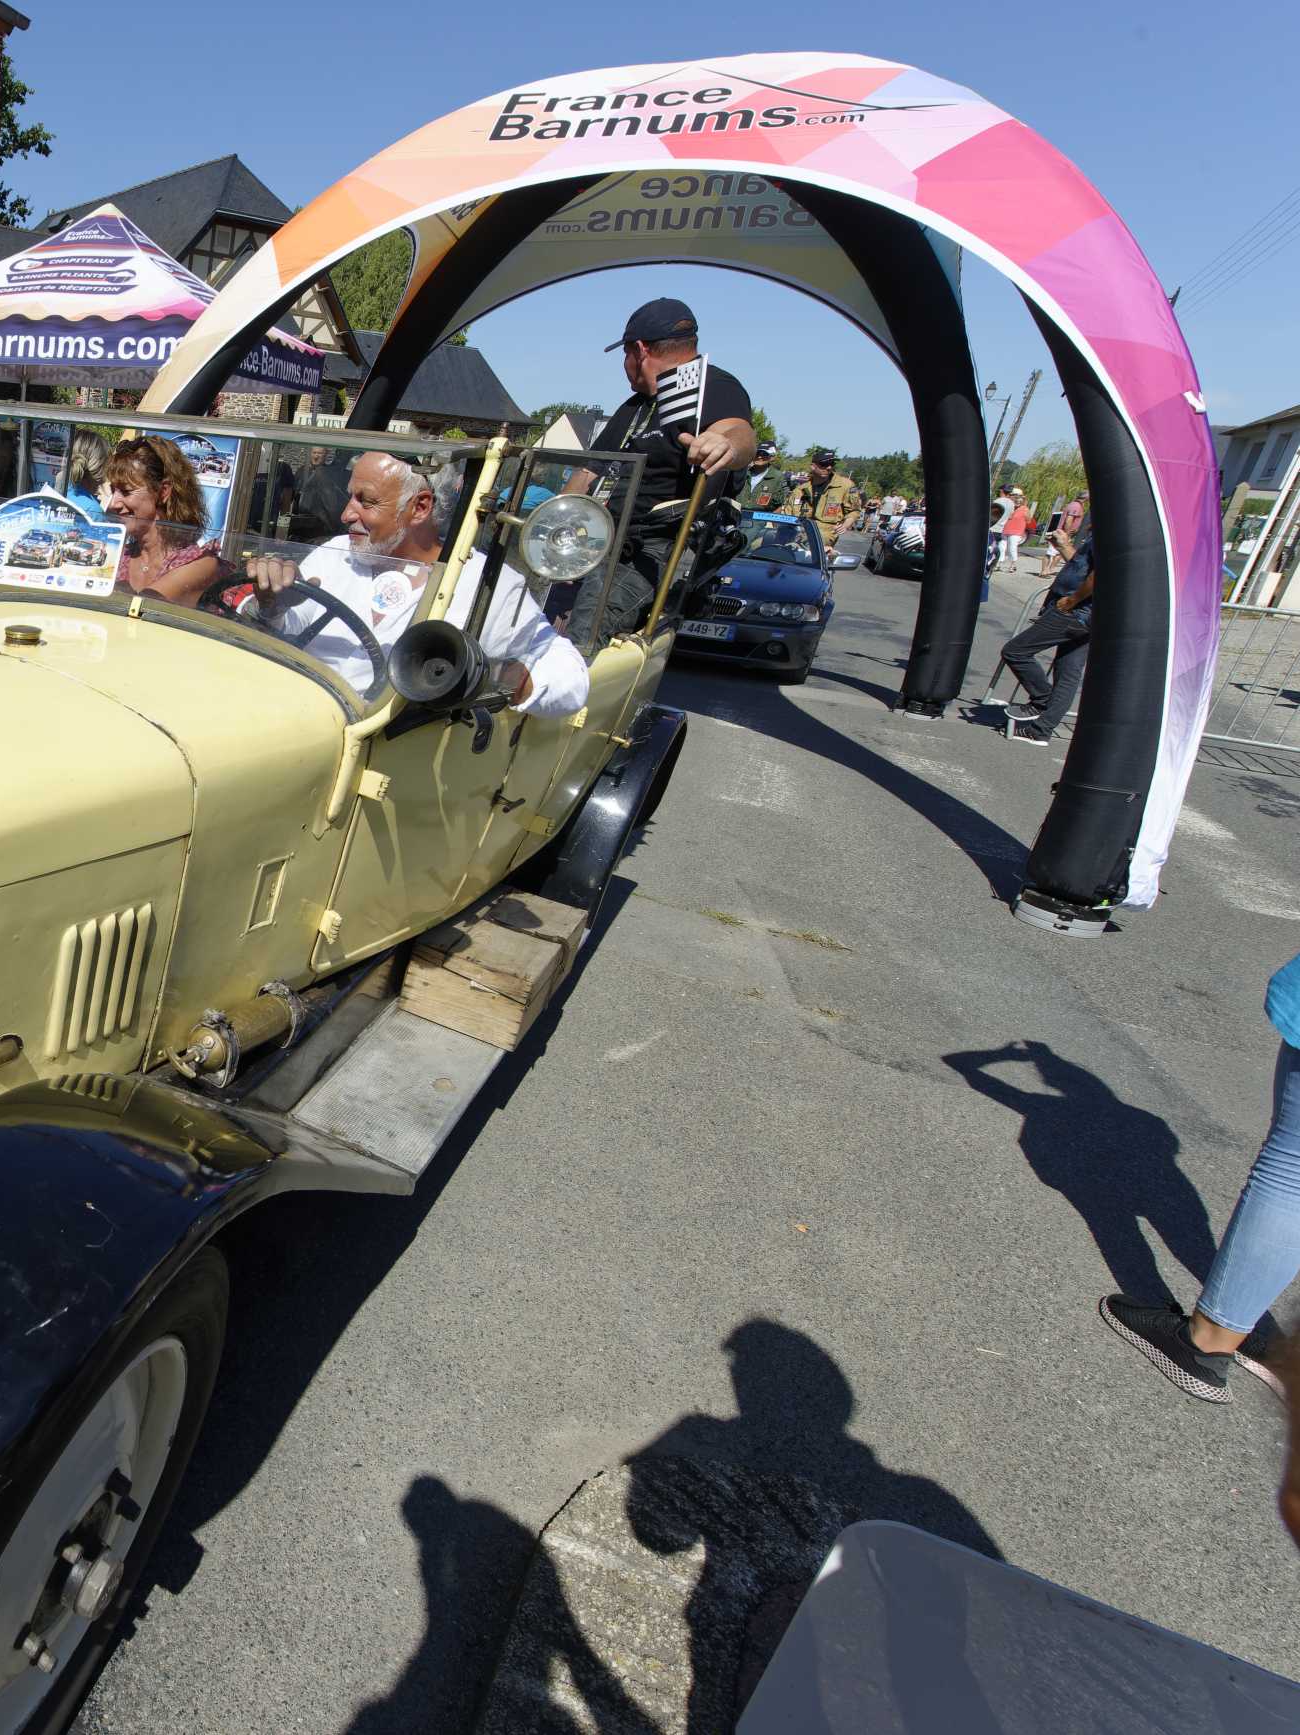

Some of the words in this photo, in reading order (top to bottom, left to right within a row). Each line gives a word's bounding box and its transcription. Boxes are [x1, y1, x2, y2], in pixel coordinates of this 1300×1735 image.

[502, 86, 733, 114] France
[11, 273, 58, 281] BARNUMS
[59, 284, 121, 292] RÉCEPTION
[241, 345, 320, 388] ce-Barnums.com
